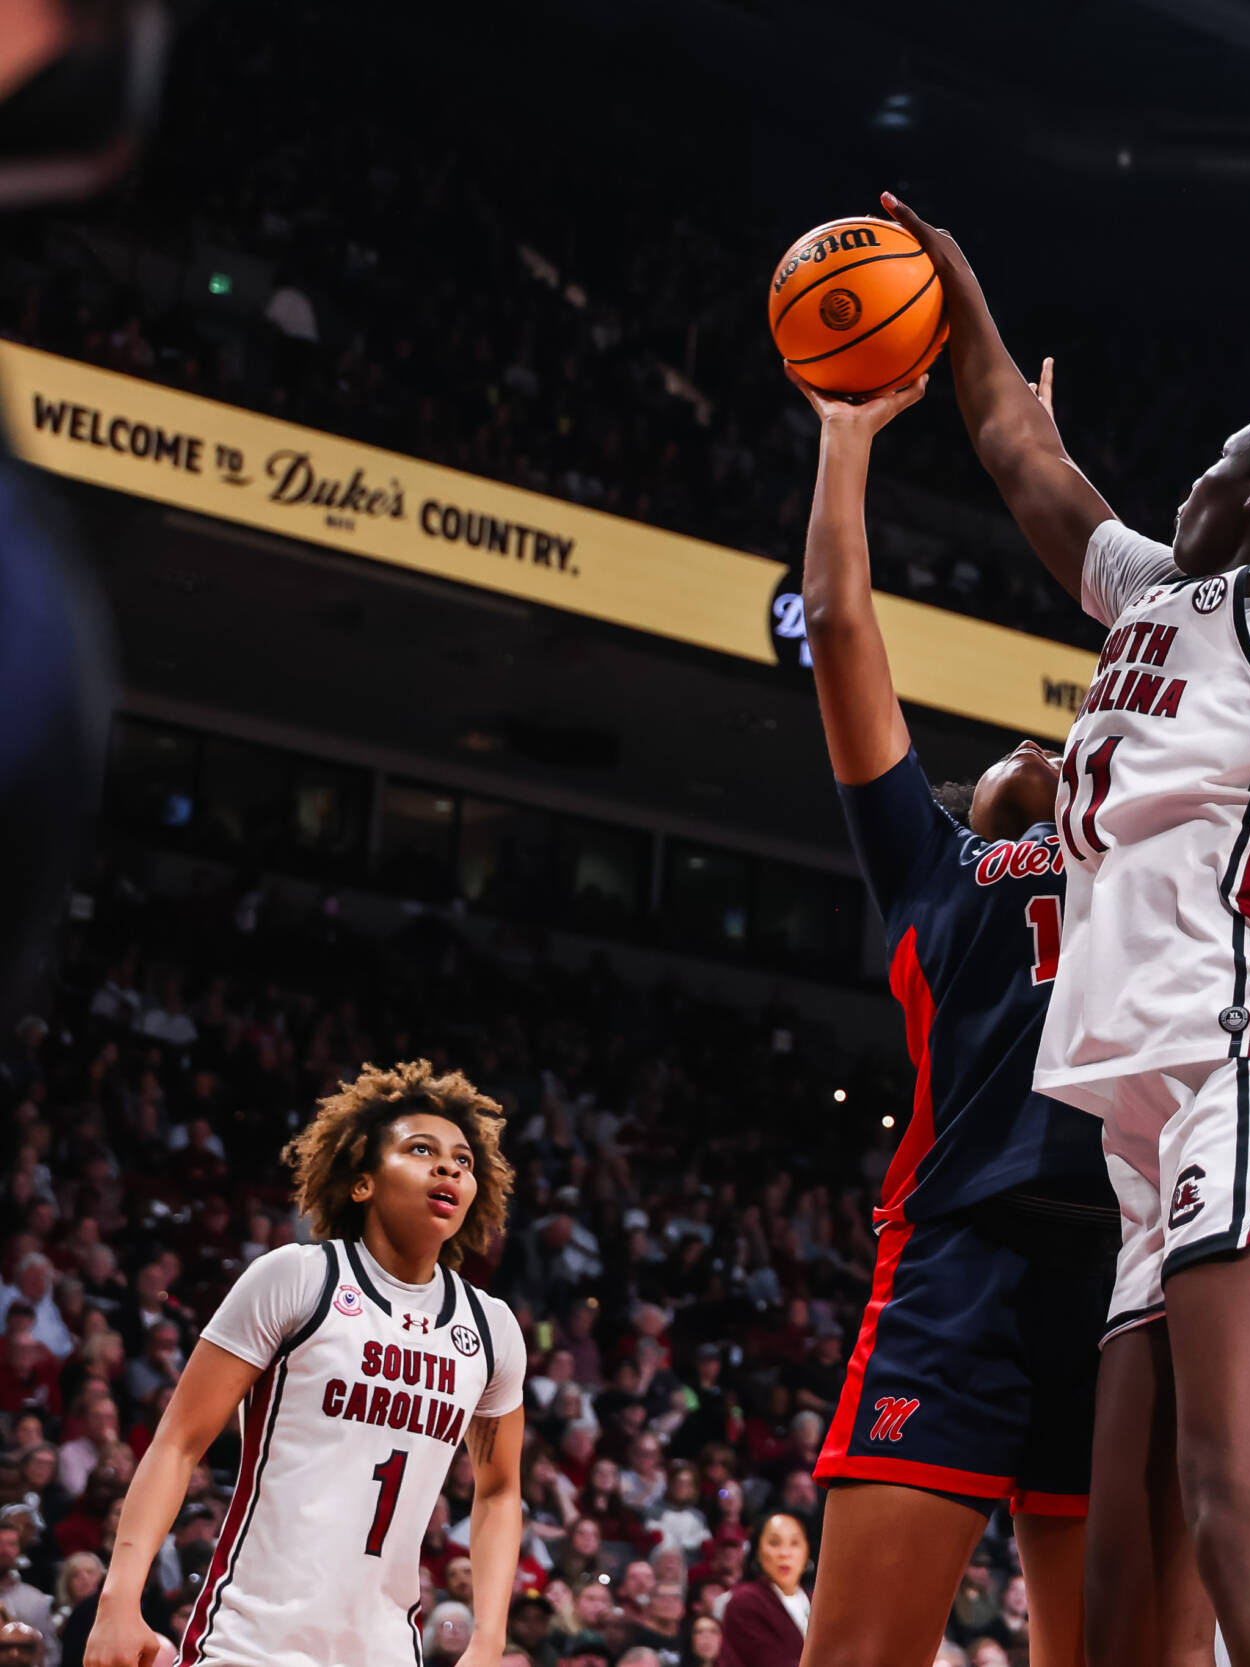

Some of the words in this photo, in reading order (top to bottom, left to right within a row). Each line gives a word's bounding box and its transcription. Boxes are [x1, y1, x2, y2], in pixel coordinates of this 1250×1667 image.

[33, 393, 205, 474] WELCOME
[215, 445, 244, 473] TO
[265, 450, 405, 518] Duke's
[420, 498, 580, 577] COUNTRY.
[1194, 577, 1226, 612] SEC
[1062, 735, 1124, 862] 11
[975, 840, 1050, 886] Ole
[361, 1340, 456, 1395] SOUTH
[452, 1325, 479, 1356] SEC
[321, 1378, 466, 1447] CAROLINA
[364, 1448, 409, 1558] 1
